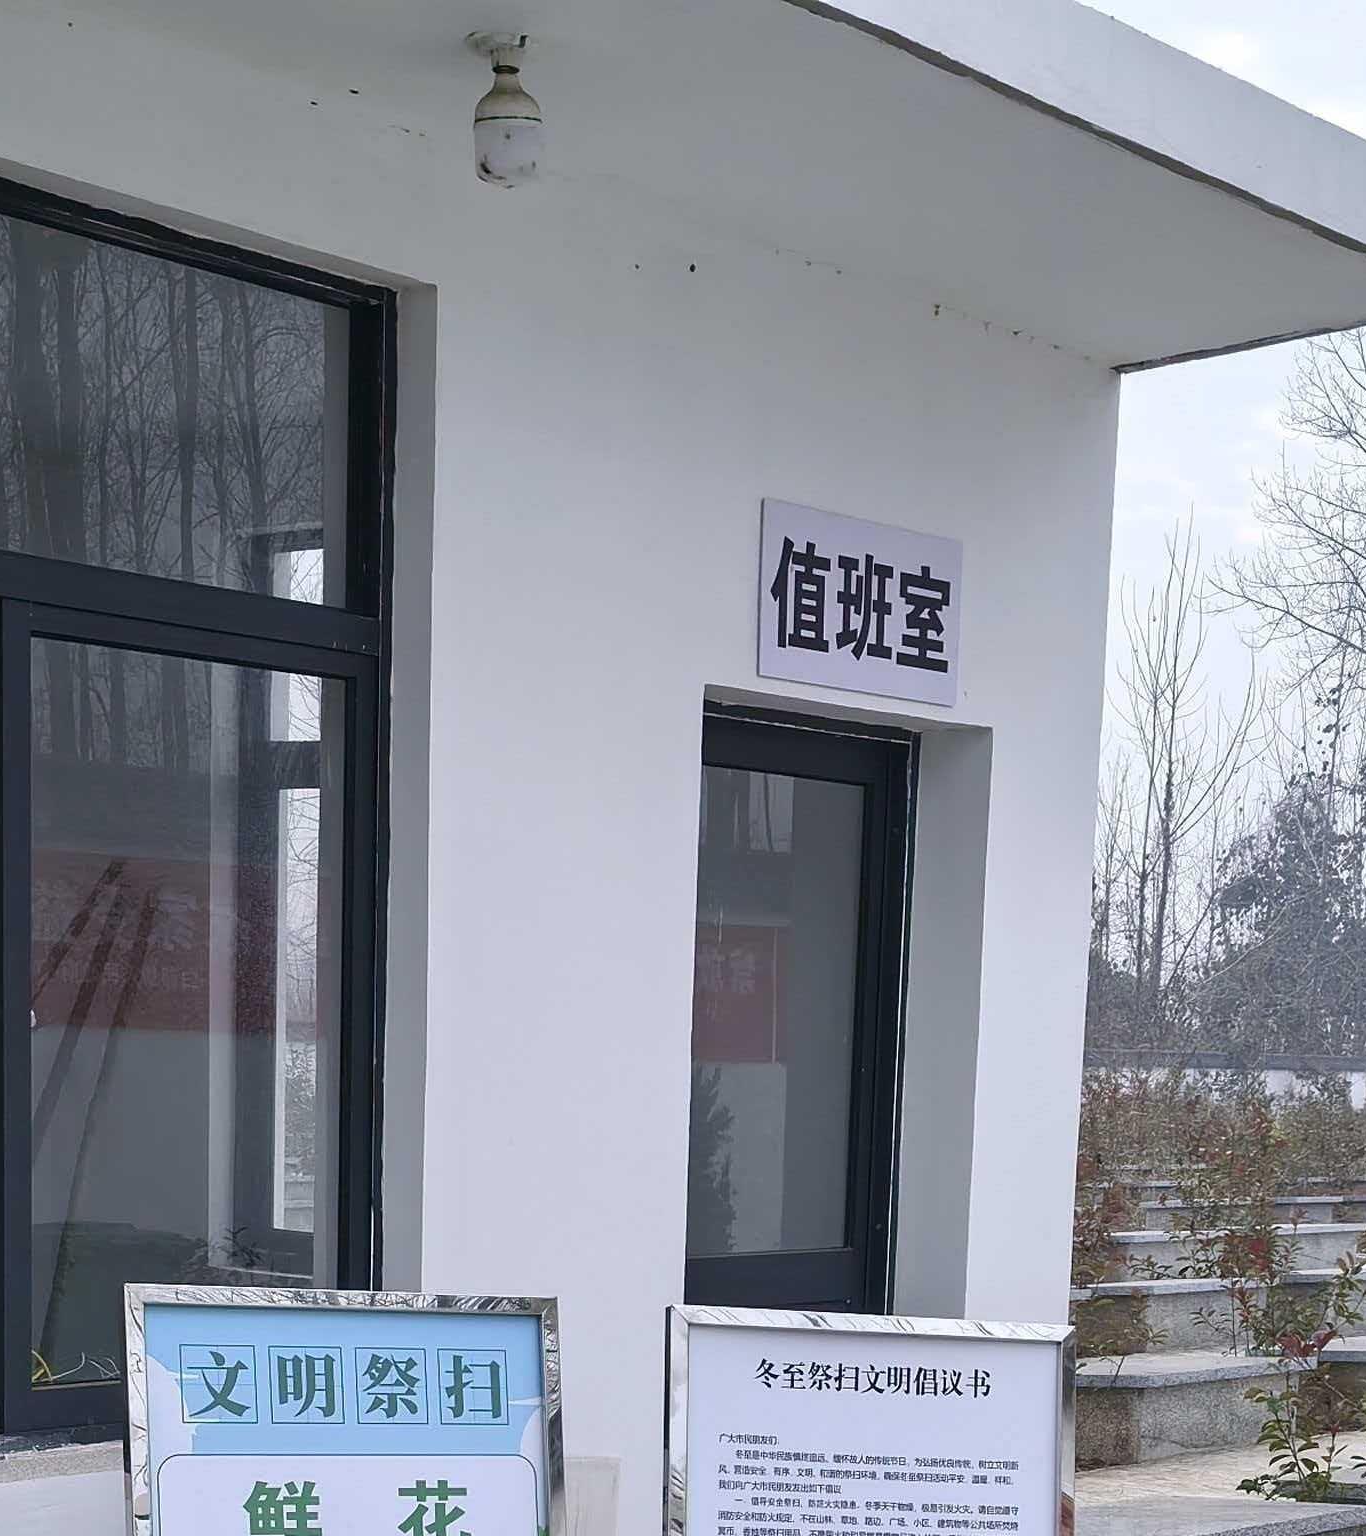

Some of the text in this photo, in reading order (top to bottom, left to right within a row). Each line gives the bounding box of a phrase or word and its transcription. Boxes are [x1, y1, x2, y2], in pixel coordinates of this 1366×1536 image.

[770, 535, 951, 674] 值班室
[185, 1350, 504, 1420] 文明祭扫
[754, 1358, 992, 1398] 冬至祭扫文明倡议书
